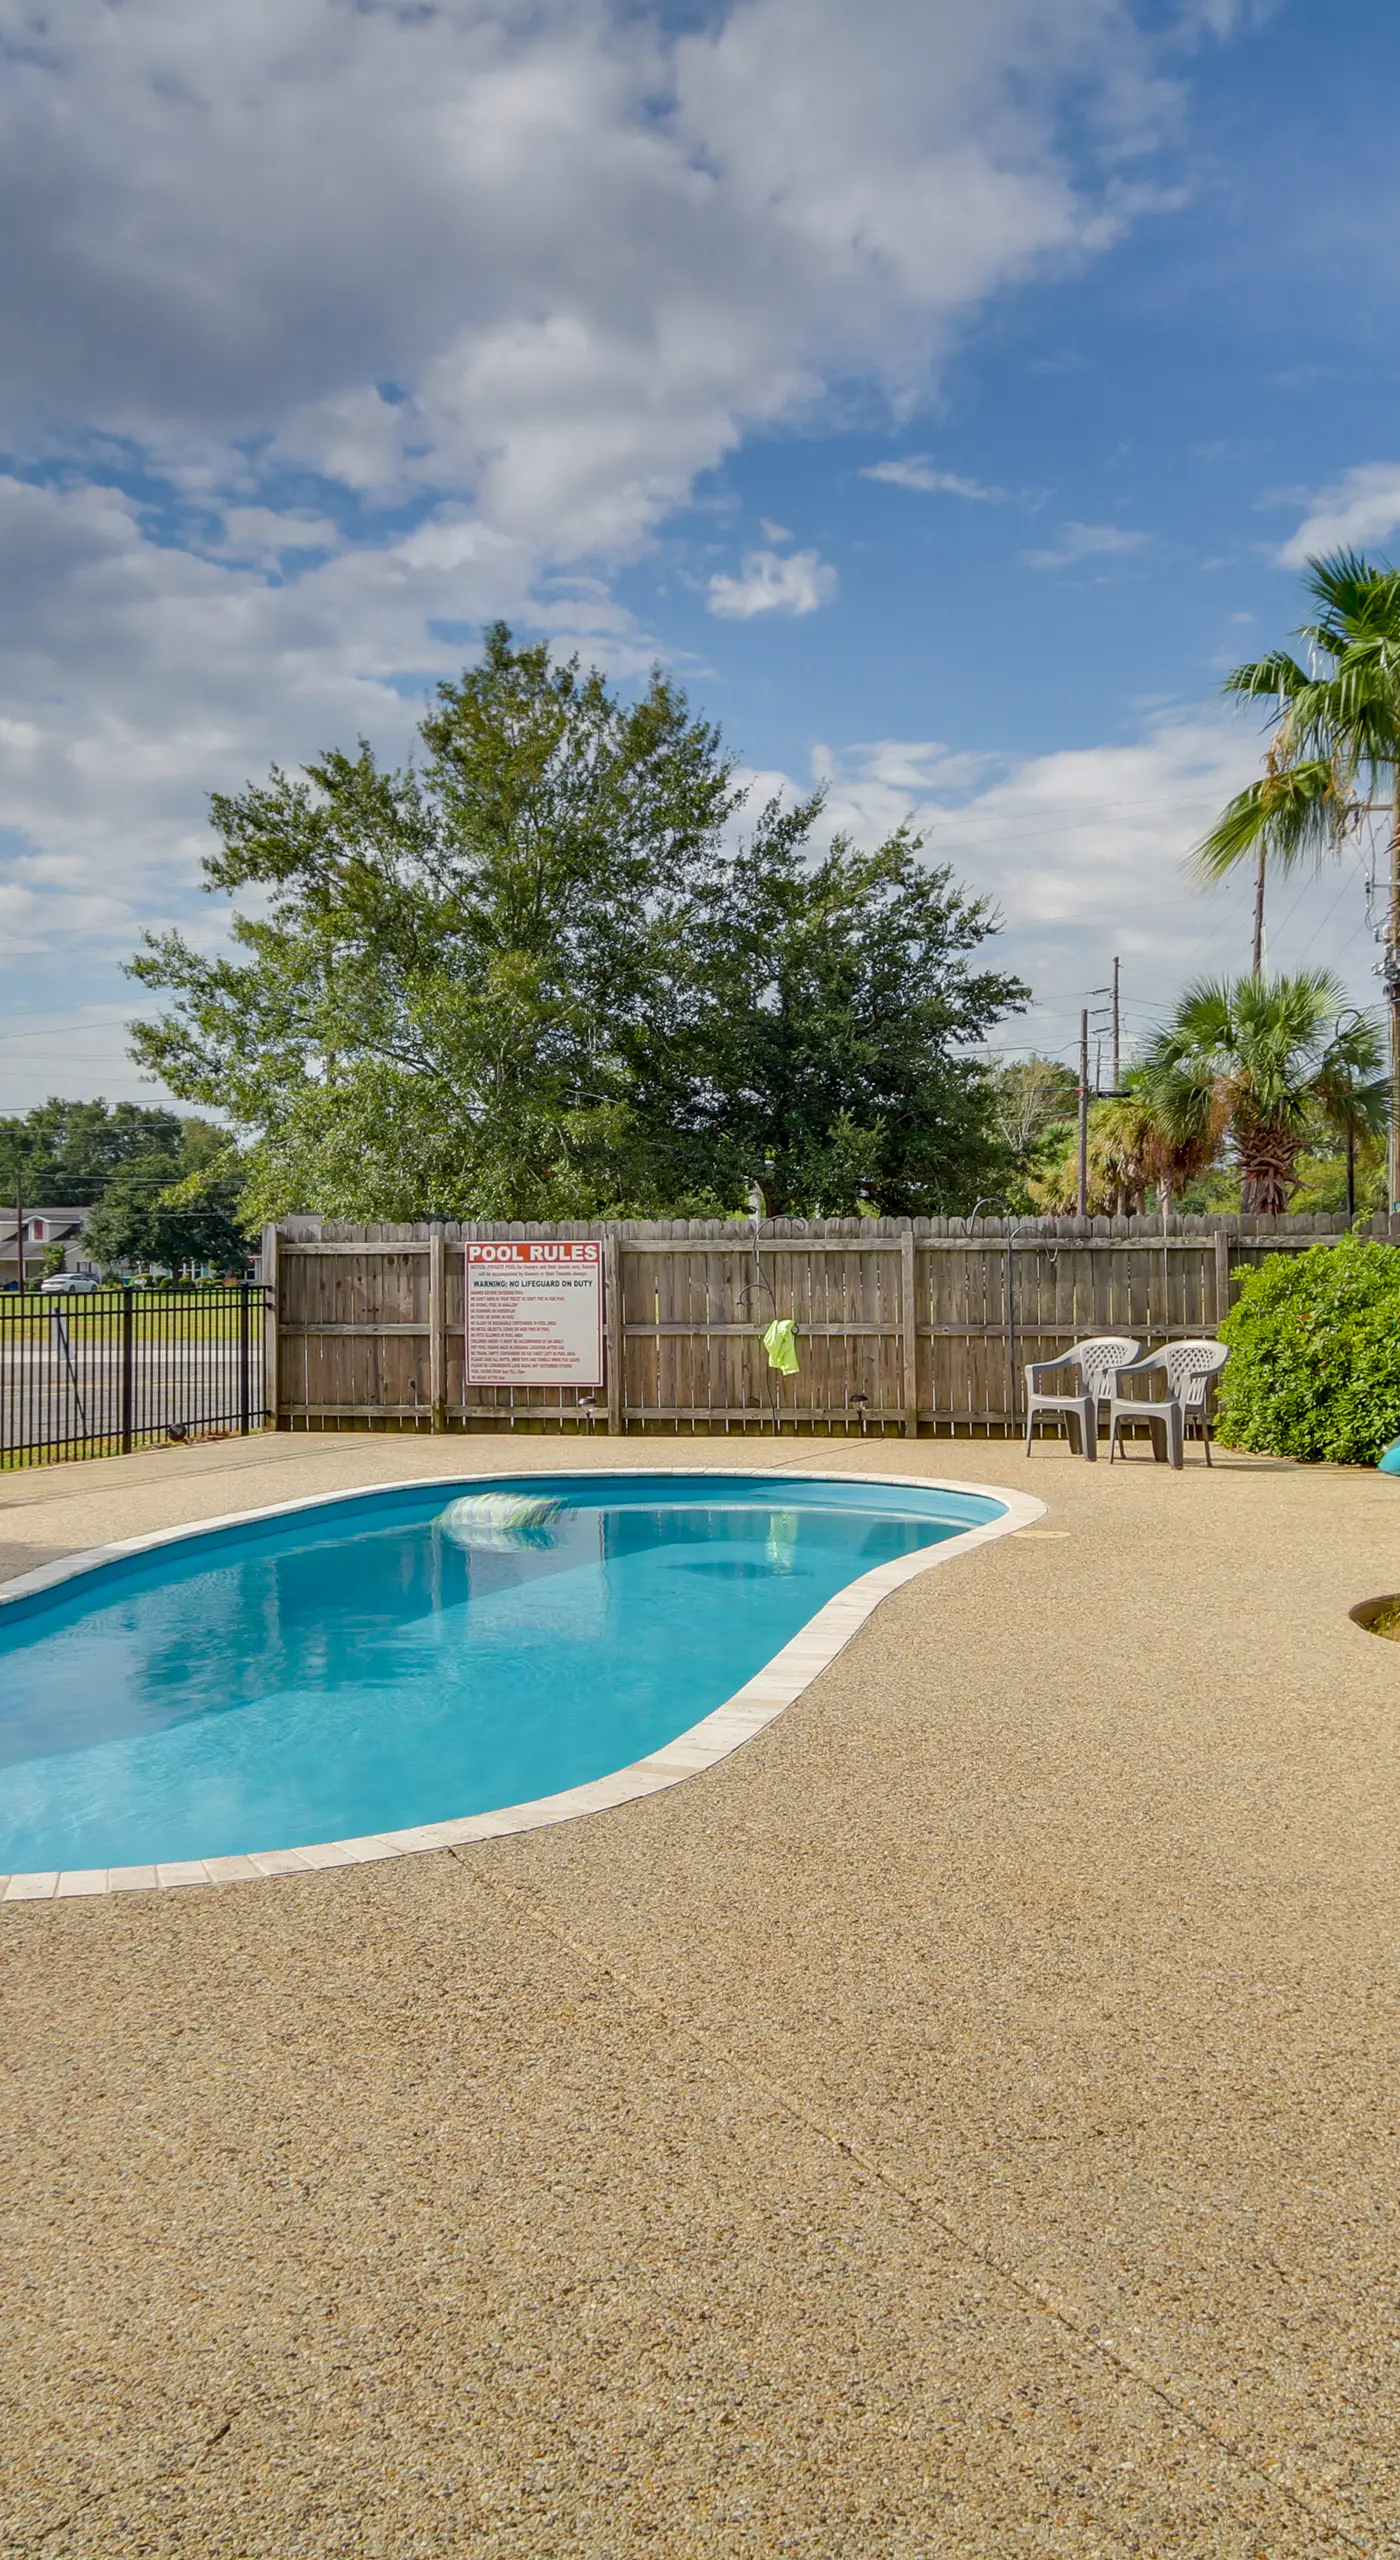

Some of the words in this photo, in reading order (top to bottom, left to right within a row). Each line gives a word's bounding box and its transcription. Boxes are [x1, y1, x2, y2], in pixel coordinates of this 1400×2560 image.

[469, 1245, 524, 1261] POOL
[530, 1245, 598, 1261] RULES
[473, 1280, 509, 1288] WARNING:
[509, 1280, 520, 1288] NO
[521, 1280, 560, 1288] LIFEGUARD
[561, 1280, 572, 1288] ON
[573, 1280, 593, 1288] DUTY
